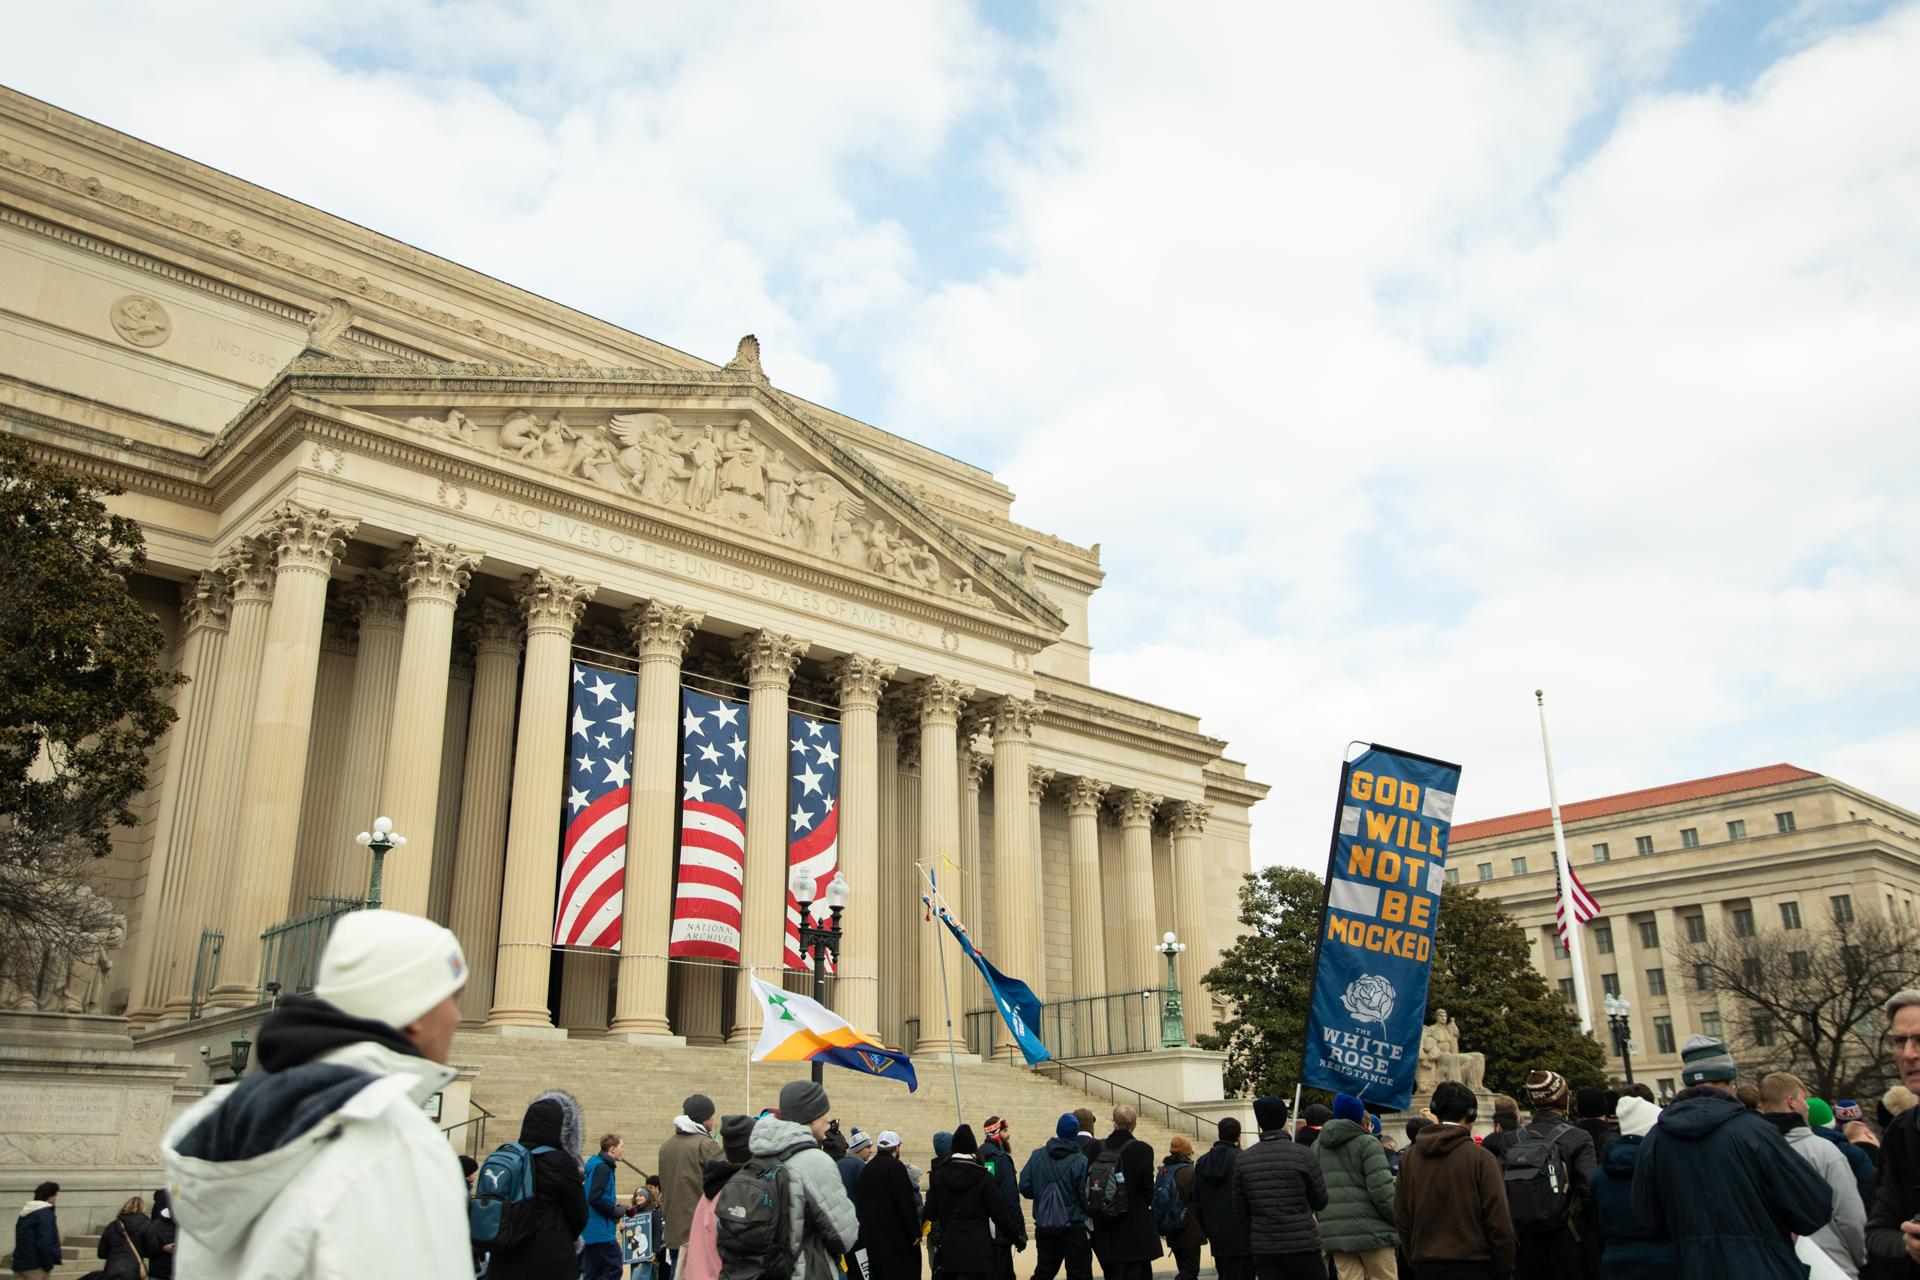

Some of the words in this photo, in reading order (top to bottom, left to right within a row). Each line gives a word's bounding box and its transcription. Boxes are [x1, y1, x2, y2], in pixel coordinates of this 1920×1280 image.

[210, 336, 279, 369] INDISSO
[491, 502, 600, 548] ARCHIVES
[608, 535, 635, 553] OF
[641, 543, 677, 570] THE
[684, 558, 754, 591] UNITED
[761, 578, 820, 609] STATES
[825, 598, 848, 616] OF
[850, 607, 927, 642] AMERICA
[1351, 770, 1419, 812] GOD
[1366, 809, 1442, 858] WILL
[1348, 844, 1425, 888] NOT
[1382, 889, 1431, 929] BE
[684, 932, 733, 944] ARCHIVES
[687, 923, 734, 935] NATIONAL
[1328, 914, 1430, 962] MOCKED
[1323, 1026, 1403, 1060] WHITE
[1355, 1027, 1371, 1036] THE
[1320, 1058, 1394, 1087] RESISTANCE
[1329, 1045, 1389, 1074] ROSE
